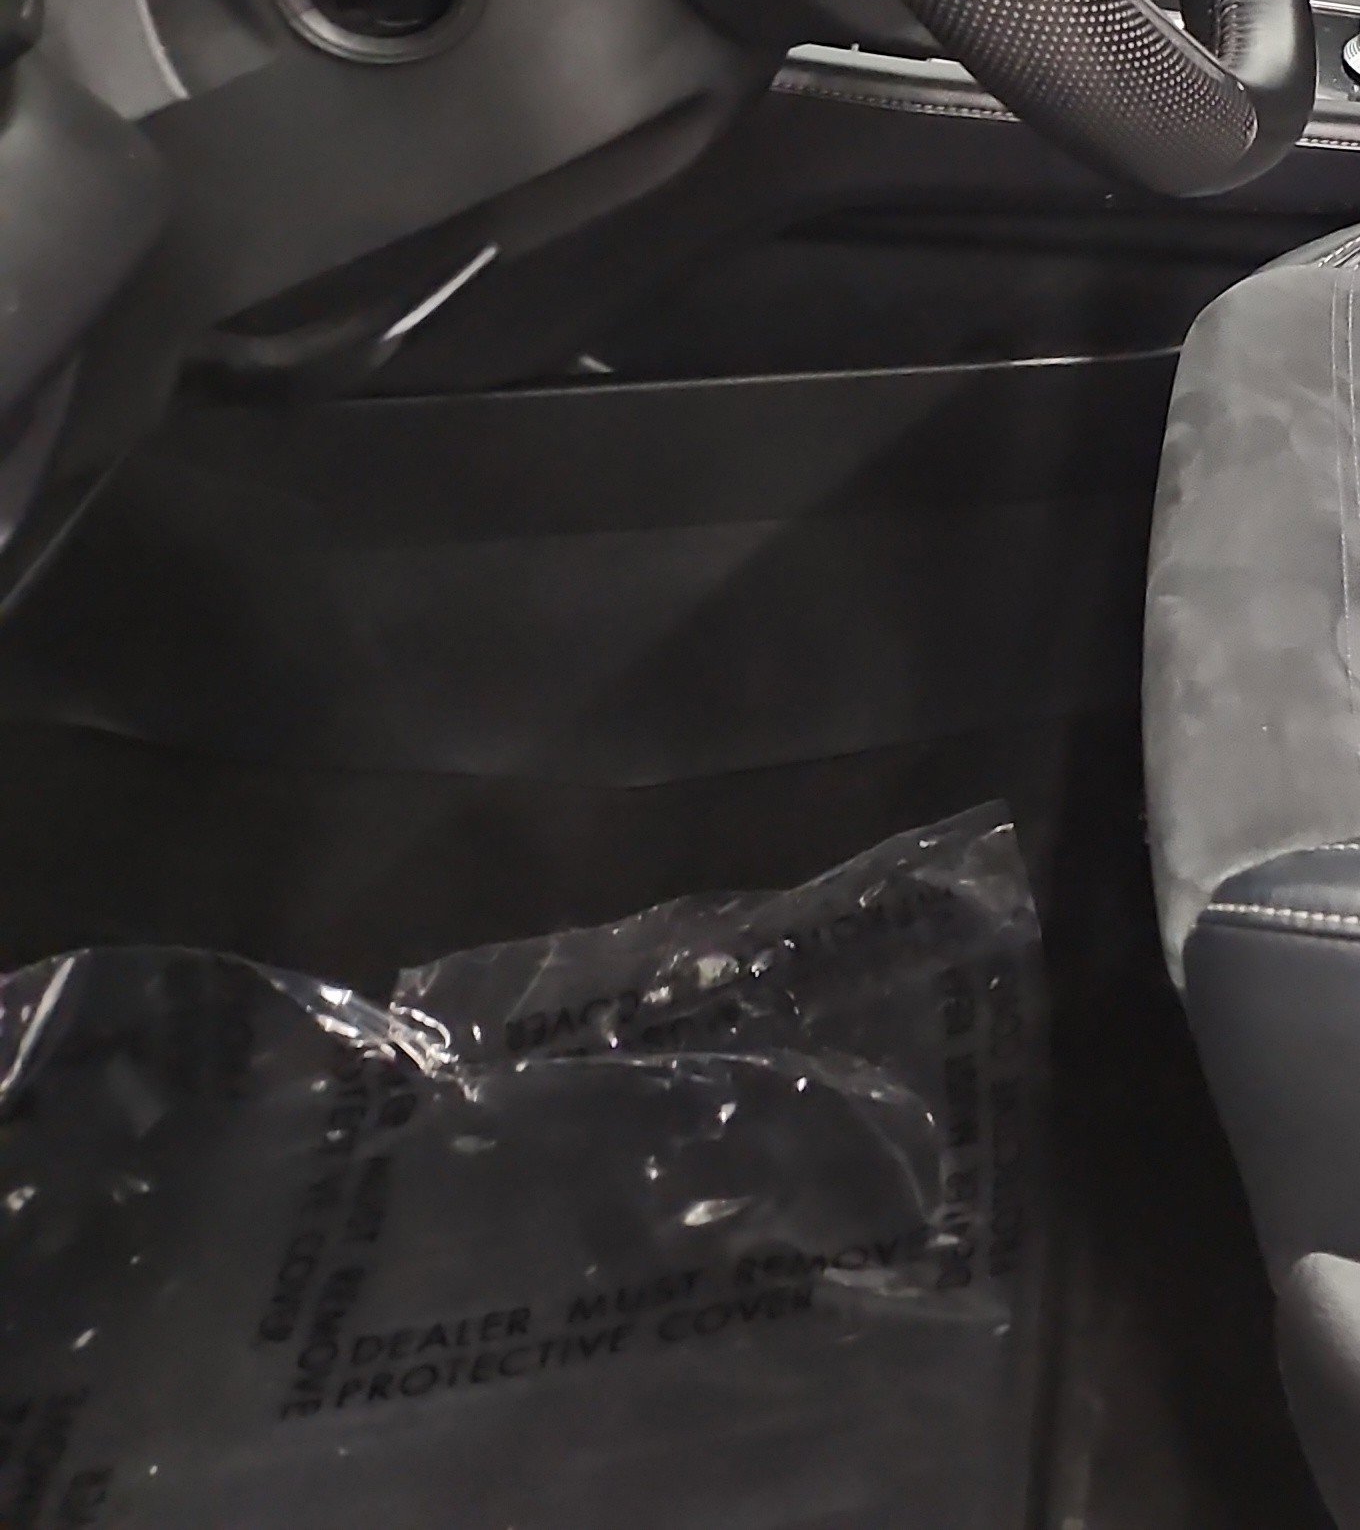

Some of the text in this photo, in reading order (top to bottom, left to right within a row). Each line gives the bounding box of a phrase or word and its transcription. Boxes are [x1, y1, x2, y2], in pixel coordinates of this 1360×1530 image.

[335, 1286, 816, 1410] PROTECTIVE COVER
[349, 1306, 535, 1367] DEALER
[566, 1266, 706, 1325] MUST
